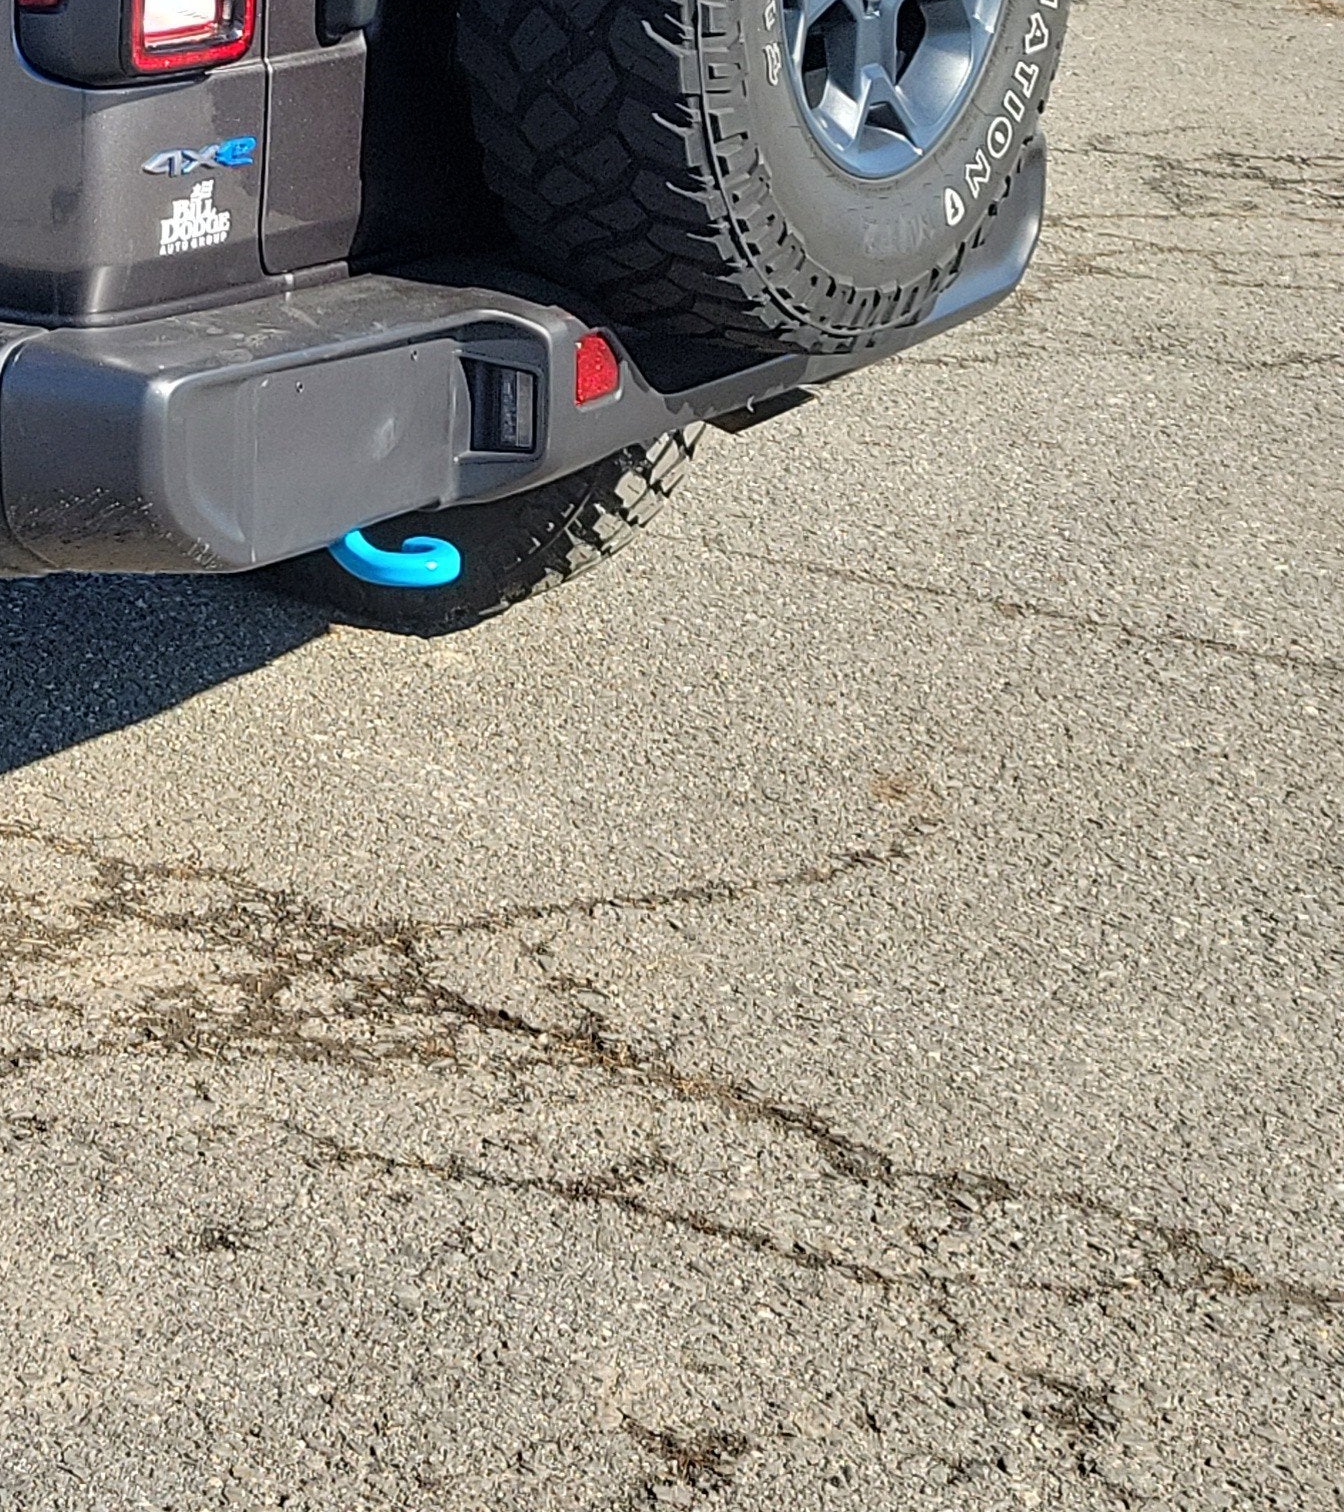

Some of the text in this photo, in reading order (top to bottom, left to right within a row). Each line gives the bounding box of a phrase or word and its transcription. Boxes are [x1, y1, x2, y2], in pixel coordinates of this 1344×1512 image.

[159, 208, 231, 245] DODGE
[159, 230, 228, 256] AUTO GROUP
